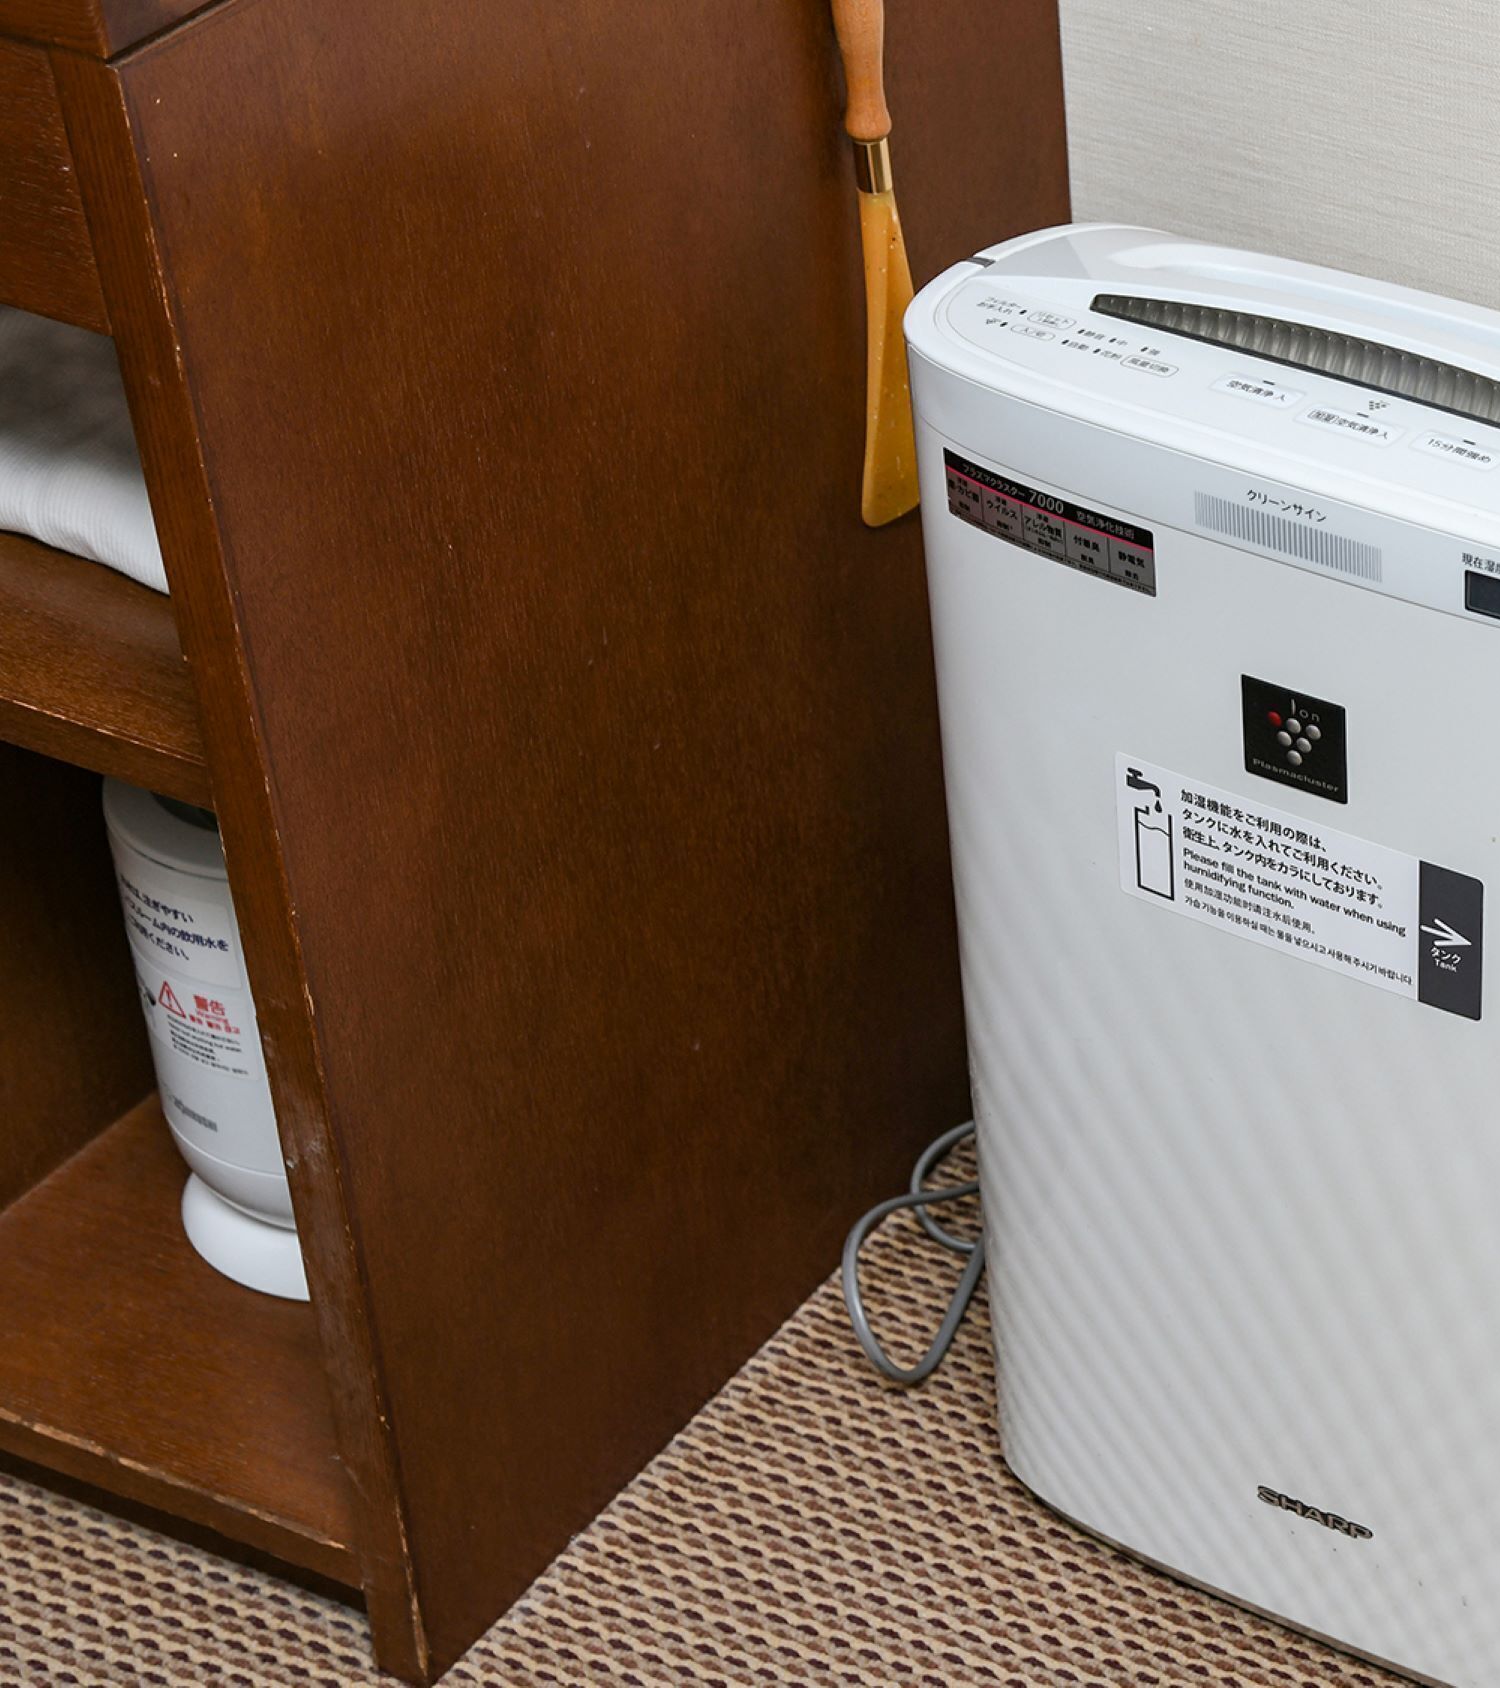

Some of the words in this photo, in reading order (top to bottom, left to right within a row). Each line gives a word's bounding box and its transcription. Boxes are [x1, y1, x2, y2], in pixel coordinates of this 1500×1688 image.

[1028, 488, 1064, 515] 7000
[1247, 489, 1327, 523] クリーンサイン
[1252, 757, 1339, 793] Plasmacluster
[1181, 788, 1327, 852] 加湿機能をご利用の際は、
[1182, 808, 1384, 890] タンクに水を入れてご利用ください。
[1183, 860, 1247, 893] humidifying
[1247, 884, 1295, 910] function.
[1183, 847, 1219, 869] Please
[1221, 861, 1235, 874] fill
[1236, 867, 1255, 881] the
[1256, 875, 1282, 891] tank
[1283, 884, 1308, 901] with
[1309, 894, 1342, 913] water
[1343, 906, 1375, 924] when
[1376, 918, 1407, 938] using
[1430, 946, 1462, 965] タンク
[1434, 957, 1458, 973] Tank
[1257, 1484, 1374, 1540] SHARP
